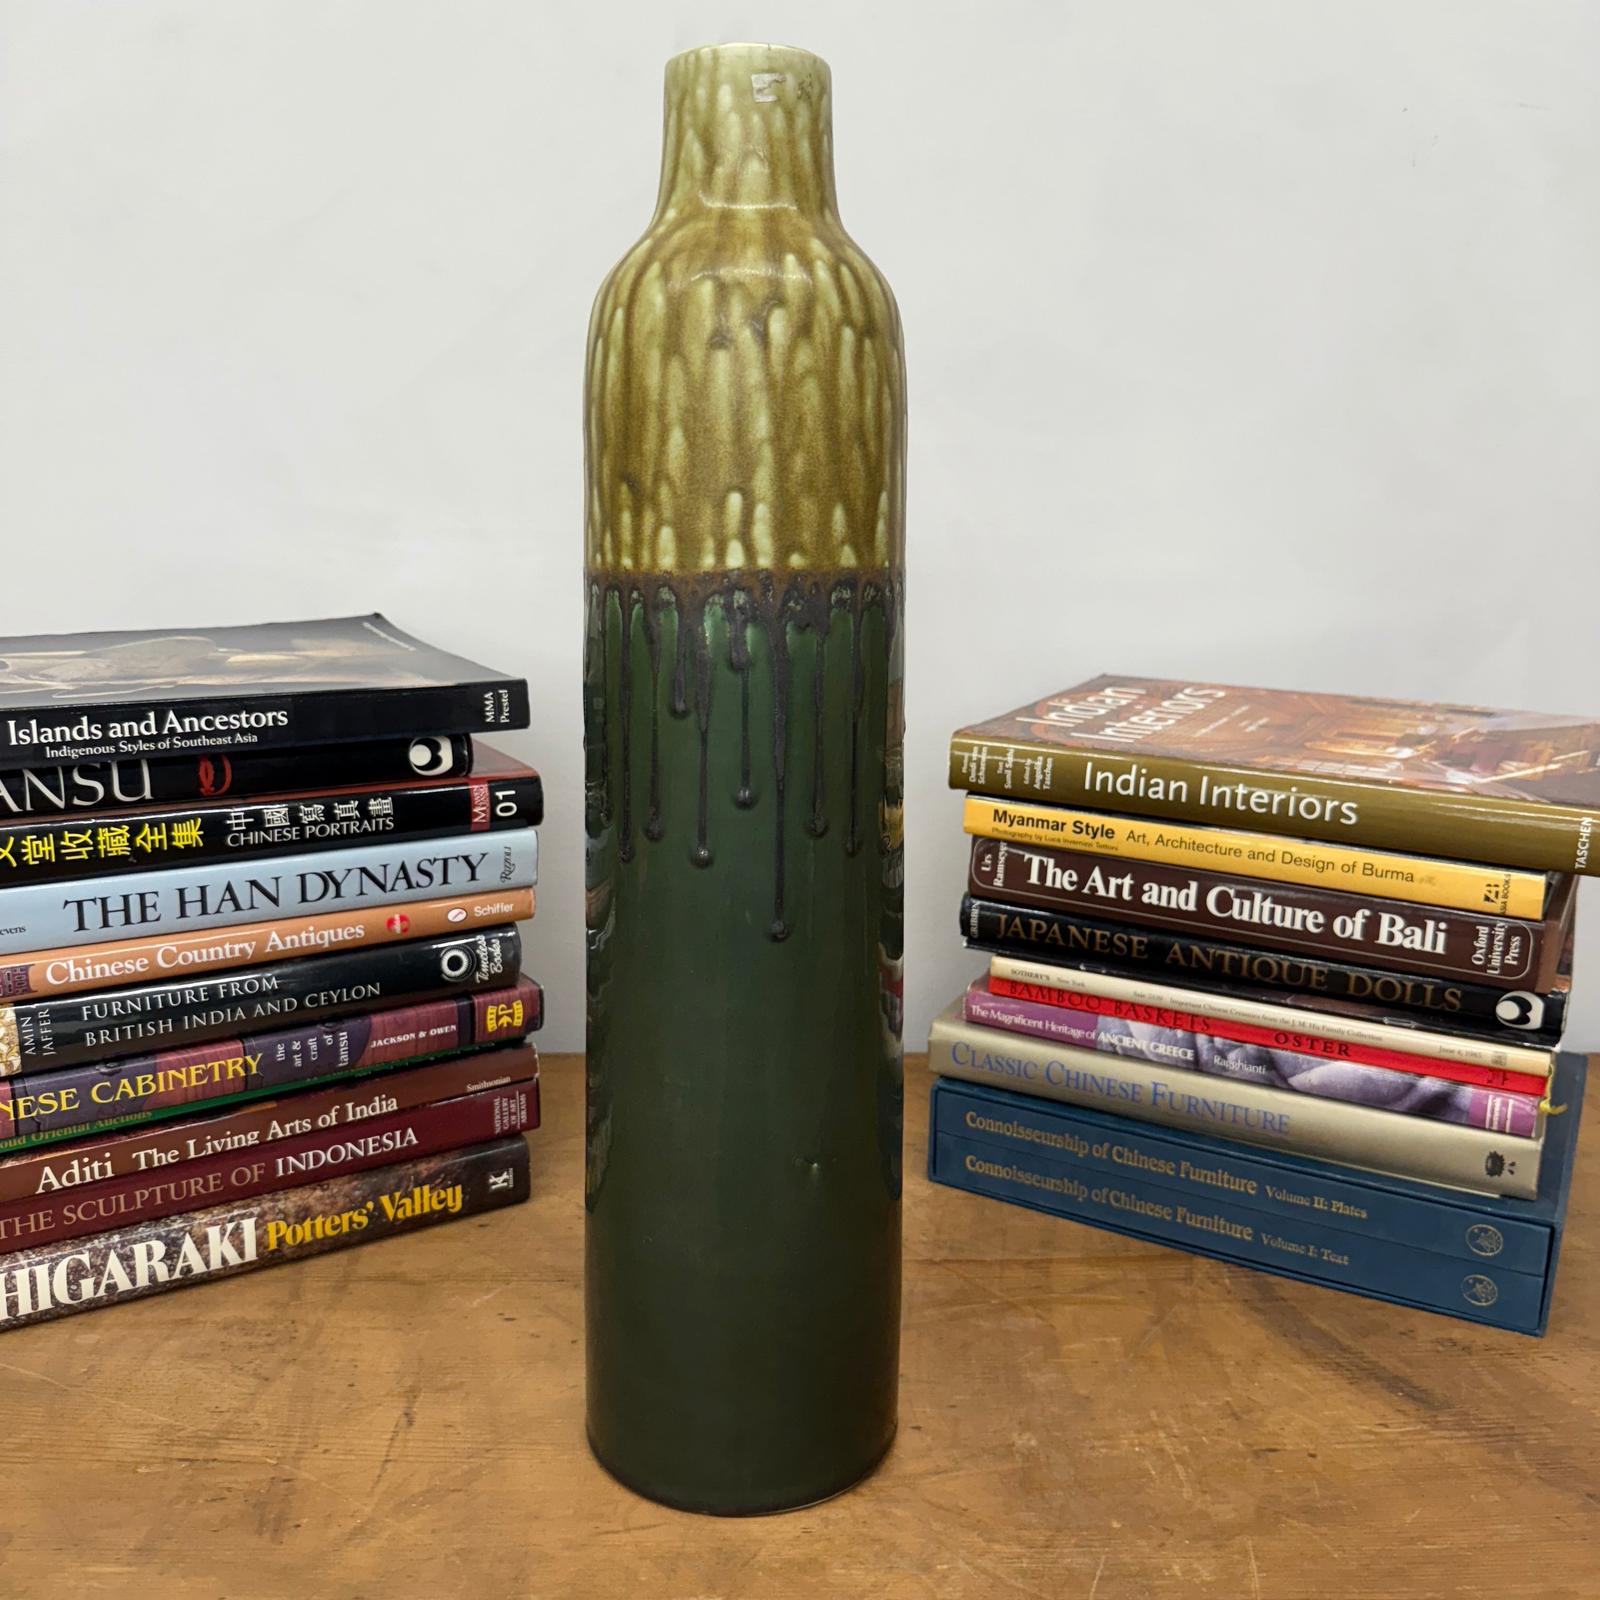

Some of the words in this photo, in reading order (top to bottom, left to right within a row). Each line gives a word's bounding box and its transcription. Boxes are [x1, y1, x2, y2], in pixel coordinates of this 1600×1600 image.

[483, 691, 495, 722] MMA
[498, 689, 510, 723] Prestel
[8, 715, 102, 746] Islands
[109, 711, 157, 738] and
[163, 709, 289, 735] Ancestors
[46, 744, 116, 759] Indigenous
[119, 741, 155, 754] Styles
[158, 739, 171, 750] of
[173, 735, 231, 749] Southeast
[235, 733, 258, 744] Asia
[495, 790, 517, 817] 01
[1084, 762, 1187, 802] Indian
[1200, 775, 1359, 826] Interiors
[227, 826, 300, 847] CHINESE
[305, 816, 394, 839] PORTRAITS
[993, 808, 1067, 833] Myanmar
[1071, 819, 1116, 840] Style
[1126, 829, 1150, 847] Art,
[1154, 836, 1243, 859] Architecture
[1247, 847, 1276, 863] and
[1280, 850, 1335, 875] Design
[1341, 859, 1357, 875] of
[1361, 862, 1415, 884] Burma
[1574, 816, 1592, 870] TASCHEN
[62, 889, 163, 933] THE
[175, 876, 282, 920] HAN
[296, 852, 489, 905] DYNASTY
[474, 901, 514, 918] Schiffer
[1024, 854, 1077, 892] The
[1082, 864, 1134, 900] Art
[1141, 880, 1199, 912] and
[1206, 885, 1325, 934] Culture
[1333, 909, 1372, 941] of
[1378, 912, 1448, 956] Bali
[45, 955, 150, 987] Chinese
[155, 940, 257, 971] Country
[265, 923, 365, 954] Antiques
[486, 938, 503, 975] Books
[997, 913, 1149, 959] JAPANESE
[1166, 942, 1329, 991] ANTIQUE
[1347, 965, 1463, 1013] DOLLS
[1472, 925, 1490, 966] Oxford
[1487, 921, 1509, 975] University
[1504, 935, 1521, 967] Press
[82, 986, 209, 1022] FURNITURE
[213, 975, 279, 1000] FROM
[85, 1018, 173, 1047] BRITISH
[184, 1007, 246, 1030] INDIA
[253, 996, 298, 1017] AND
[305, 982, 381, 1010] CEYLON
[21, 1016, 36, 1056] AMIN
[324, 1032, 334, 1046] of
[370, 1031, 416, 1049] JACKSON
[418, 1028, 427, 1039] &
[429, 1023, 457, 1037] OWEN
[971, 1004, 989, 1019] The
[990, 1009, 1044, 1029] Magnificent
[1045, 1020, 1086, 1040] Heritage
[1086, 1028, 1097, 1041] of
[1150, 1041, 1195, 1061] GREECE
[1213, 1054, 1268, 1076] Ragghianti
[1010, 981, 1101, 1011] BAMBOO
[1114, 1000, 1212, 1033] BASKETS
[1274, 1032, 1351, 1058] OSTER
[276, 1042, 286, 1062] the
[293, 1040, 303, 1052] &
[293, 1053, 303, 1068] art
[308, 1036, 317, 1061] craft
[338, 1030, 349, 1067] tansu
[90, 1053, 262, 1105] CABINETRY
[466, 1075, 511, 1093] Smithsonian
[35, 1152, 114, 1195] Aditi
[132, 1149, 180, 1171] The
[186, 1130, 260, 1158] Living
[266, 1119, 312, 1141] Arts
[318, 1106, 340, 1127] of
[347, 1094, 398, 1121] India
[0, 1208, 56, 1241] THE
[62, 1170, 224, 1226] SCULPTURE
[230, 1162, 266, 1187] OF
[276, 1127, 419, 1178] INDONESIA
[965, 1111, 1089, 1158] Connoisseurship
[1092, 1142, 1111, 1160] of
[1112, 1145, 1176, 1175] Chinese
[1179, 1160, 1258, 1195] Furniture
[1265, 1185, 1310, 1207] Volume
[1312, 1196, 1329, 1212] II:
[1331, 1200, 1368, 1220] Plates
[266, 1200, 375, 1250] Potters'
[378, 1184, 462, 1223] Valley
[965, 1155, 1087, 1202] Connoisseurship
[1091, 1186, 1111, 1203] of
[1109, 1190, 1172, 1222] Chinese
[1175, 1206, 1254, 1241] Furniture
[1260, 1231, 1307, 1254] Volume
[1320, 1247, 1350, 1267] Text
